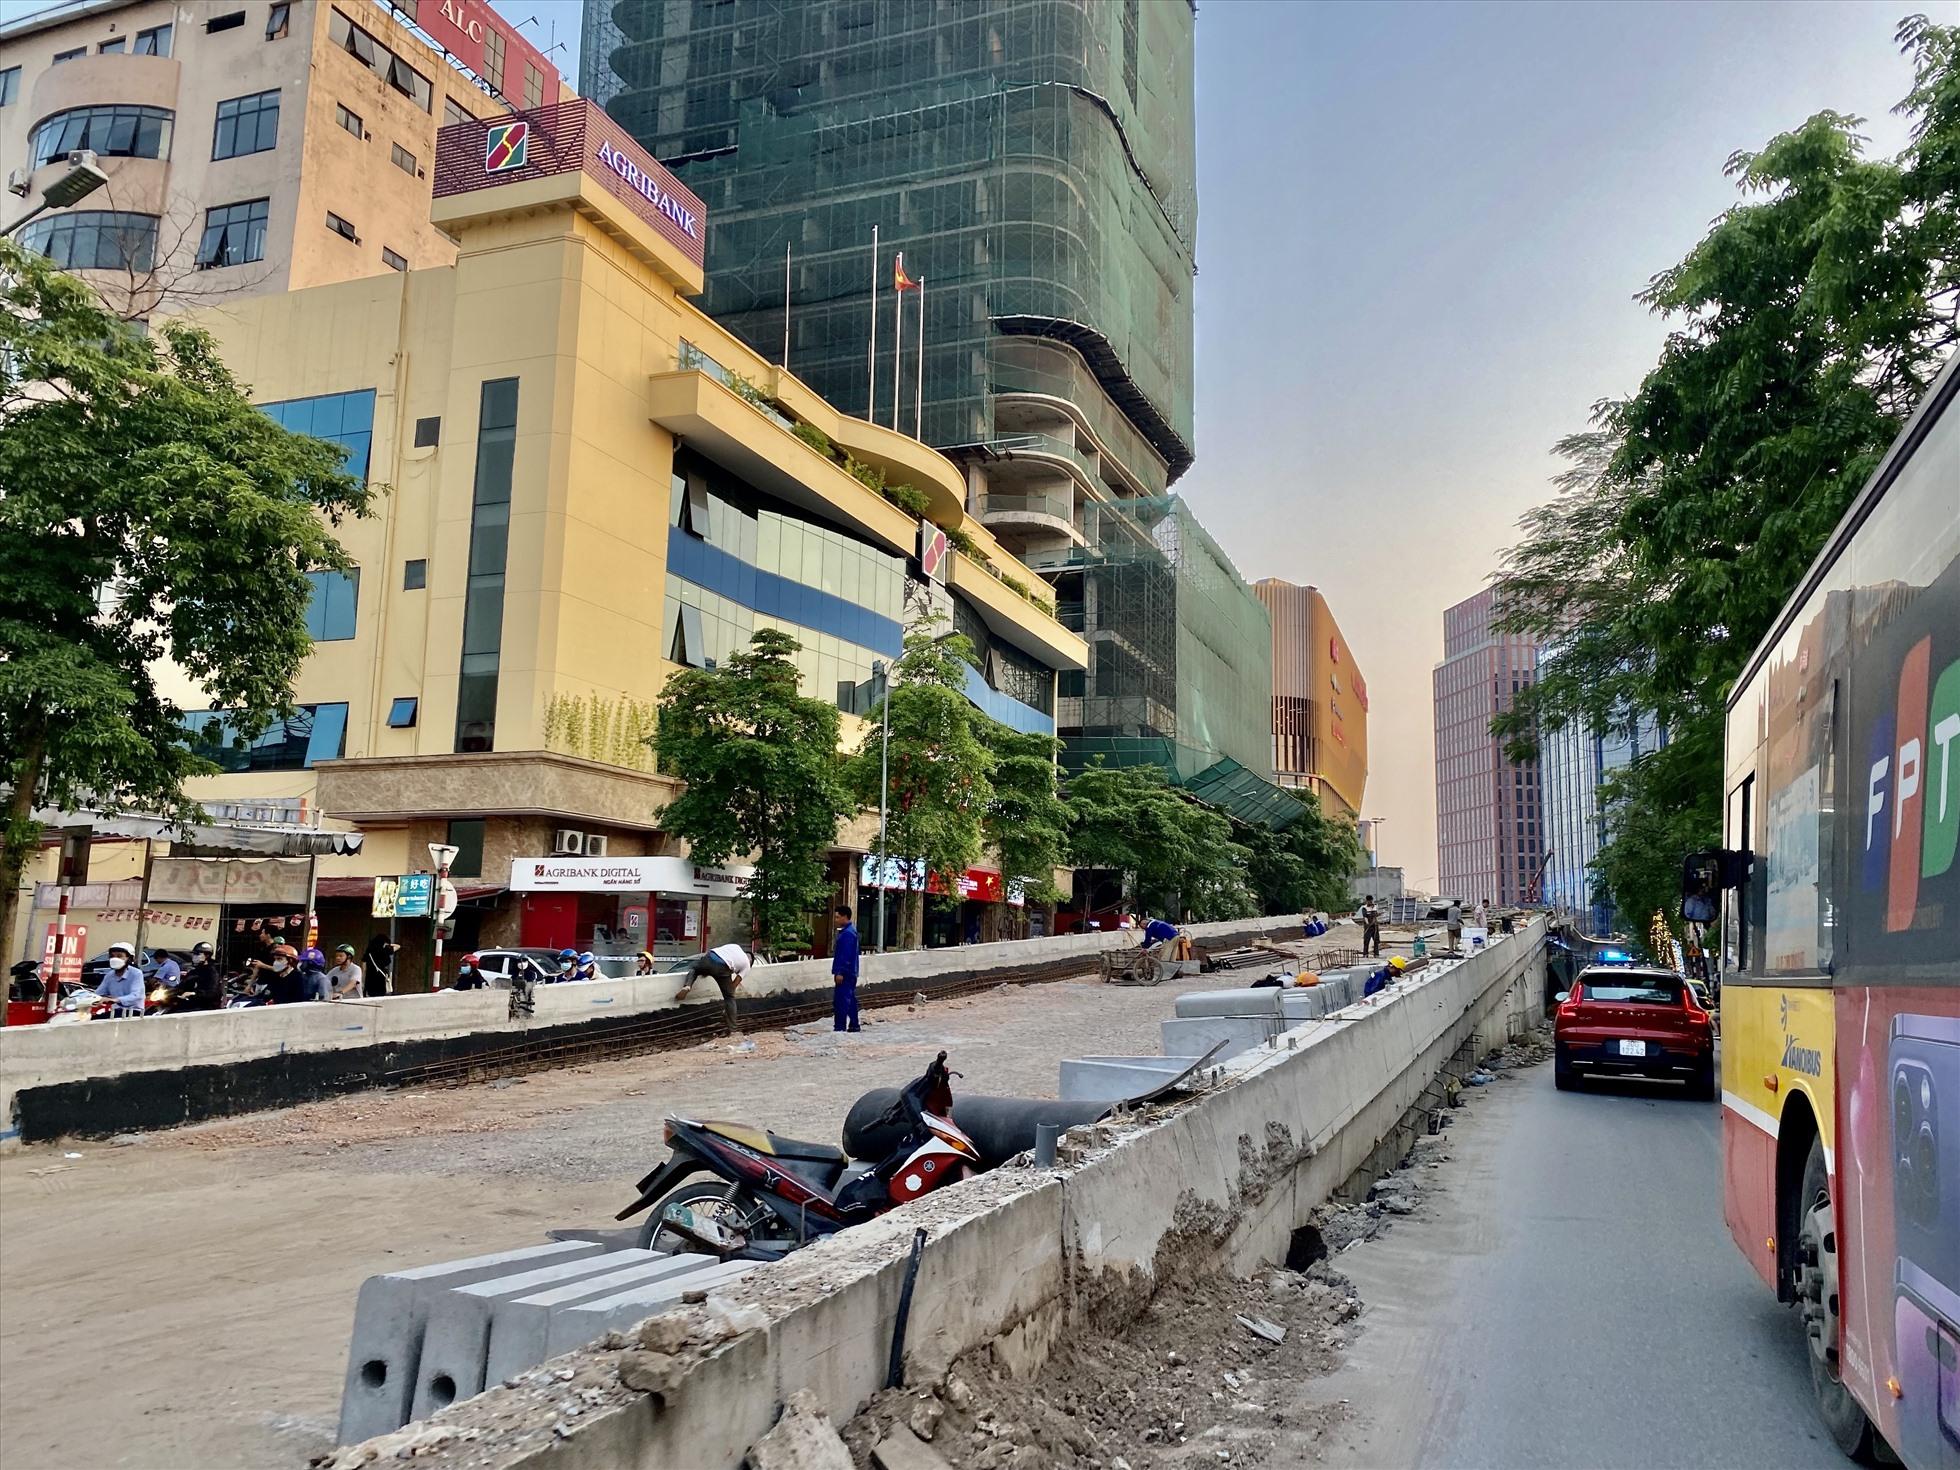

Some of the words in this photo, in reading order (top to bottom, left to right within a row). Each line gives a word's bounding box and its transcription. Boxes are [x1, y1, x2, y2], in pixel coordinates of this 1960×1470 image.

[439, 0, 483, 44] ALC
[597, 139, 697, 240] AGRIBANK
[1866, 713, 1960, 852] FPT
[545, 867, 598, 878] AGRIBANK
[600, 867, 641, 878] DIGITAL
